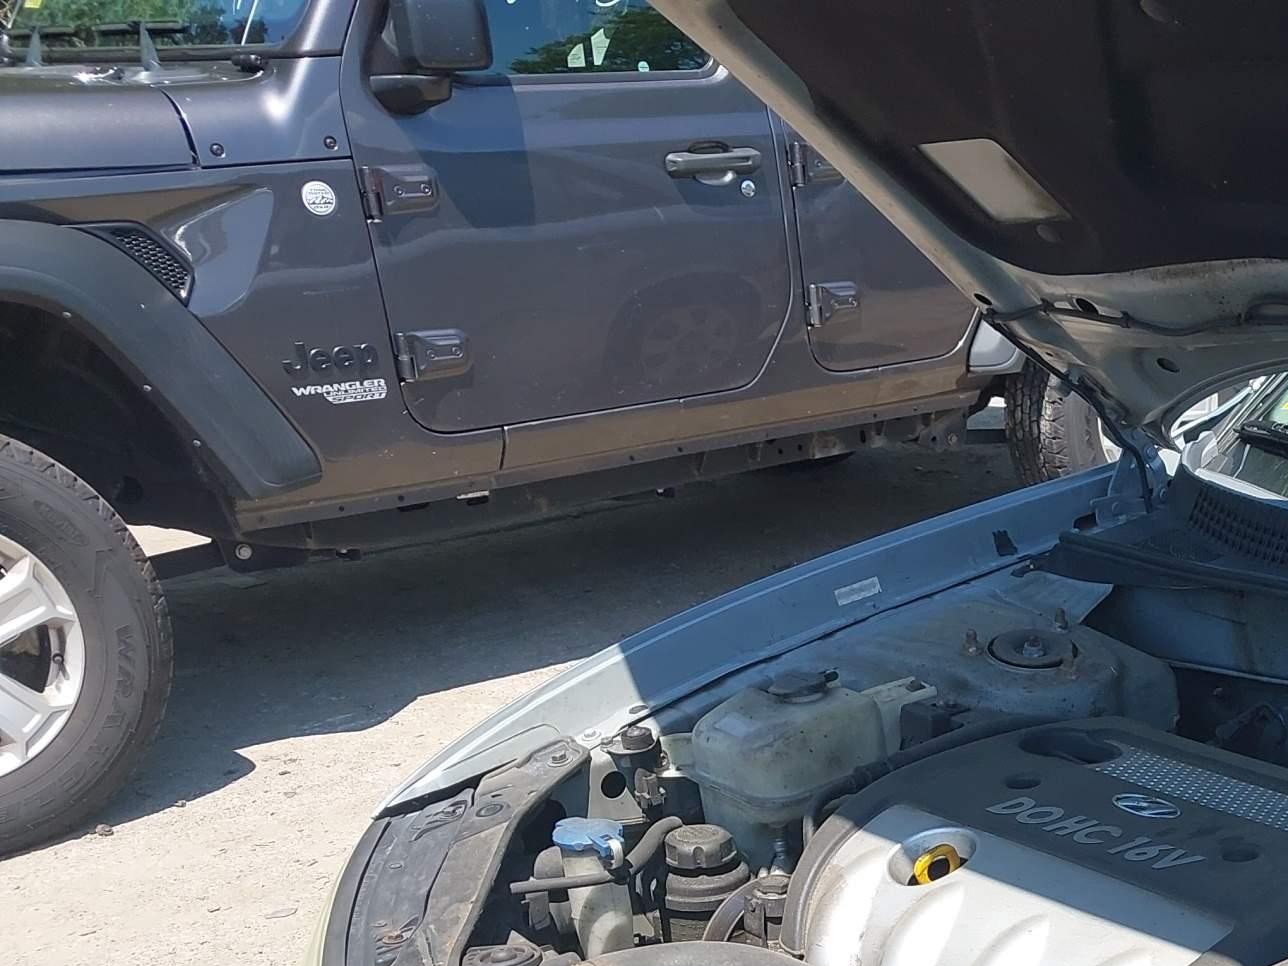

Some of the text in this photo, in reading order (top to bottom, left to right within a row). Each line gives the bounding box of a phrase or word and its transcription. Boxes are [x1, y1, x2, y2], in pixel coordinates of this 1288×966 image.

[282, 341, 379, 377] Jeep
[291, 379, 385, 396] WRANGLER
[324, 386, 387, 397] UNLIMITED
[330, 391, 384, 402] SPORT
[985, 796, 1206, 870] DOHC 16V
